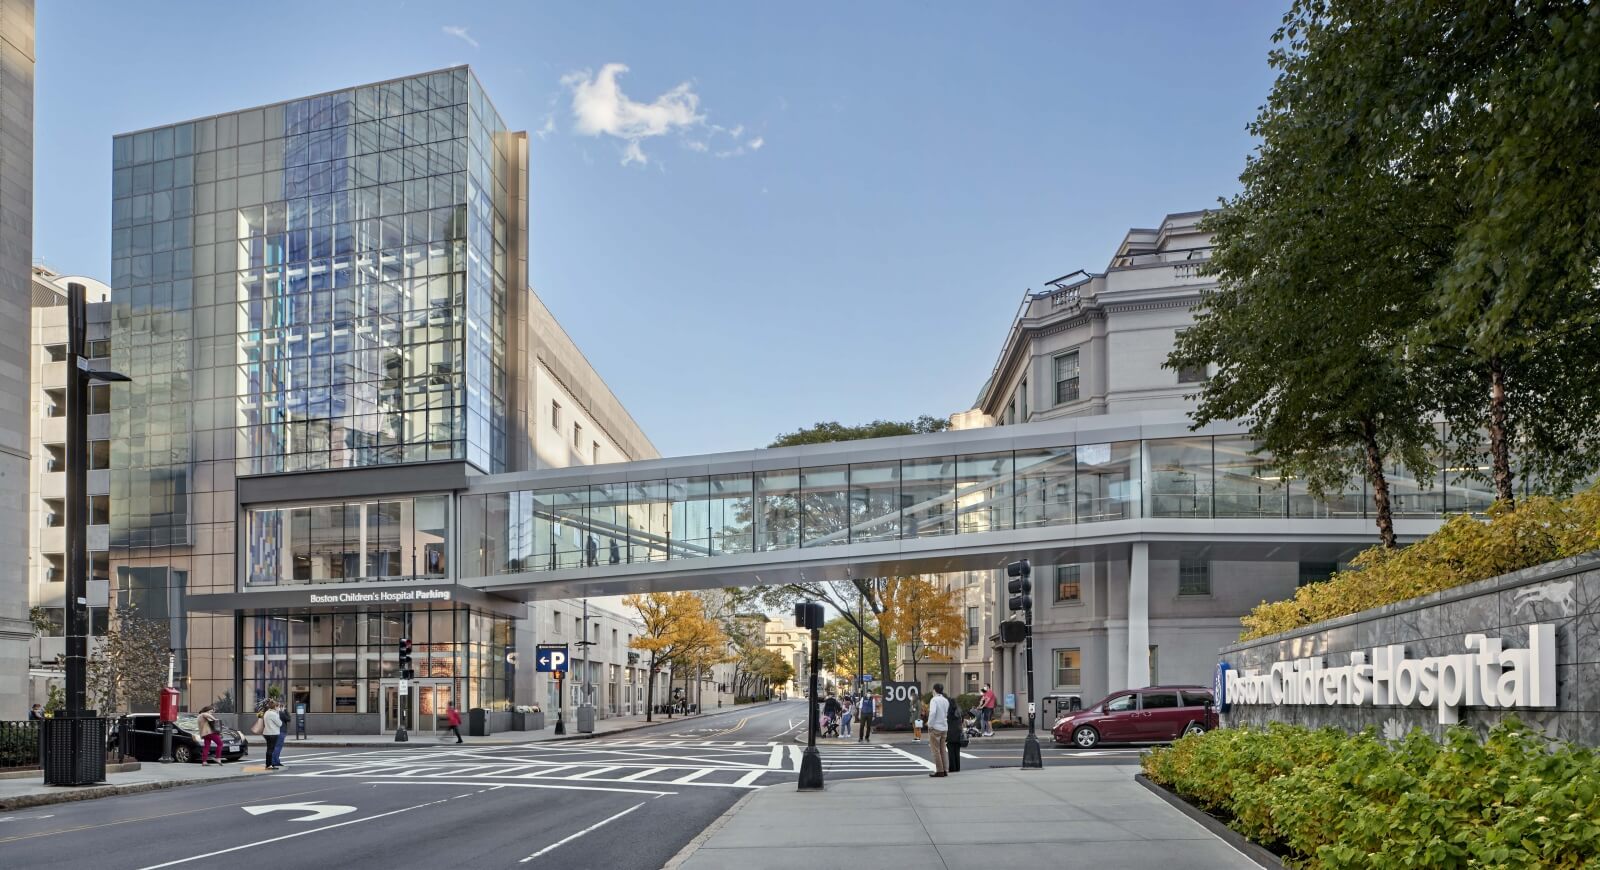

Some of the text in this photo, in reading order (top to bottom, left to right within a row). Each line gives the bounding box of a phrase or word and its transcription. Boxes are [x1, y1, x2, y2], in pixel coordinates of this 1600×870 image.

[310, 589, 450, 604] Boston Children's Hospital Parking
[550, 651, 565, 671] P
[1225, 623, 1557, 725] Boston Children's Hospital
[885, 685, 919, 701] 300
